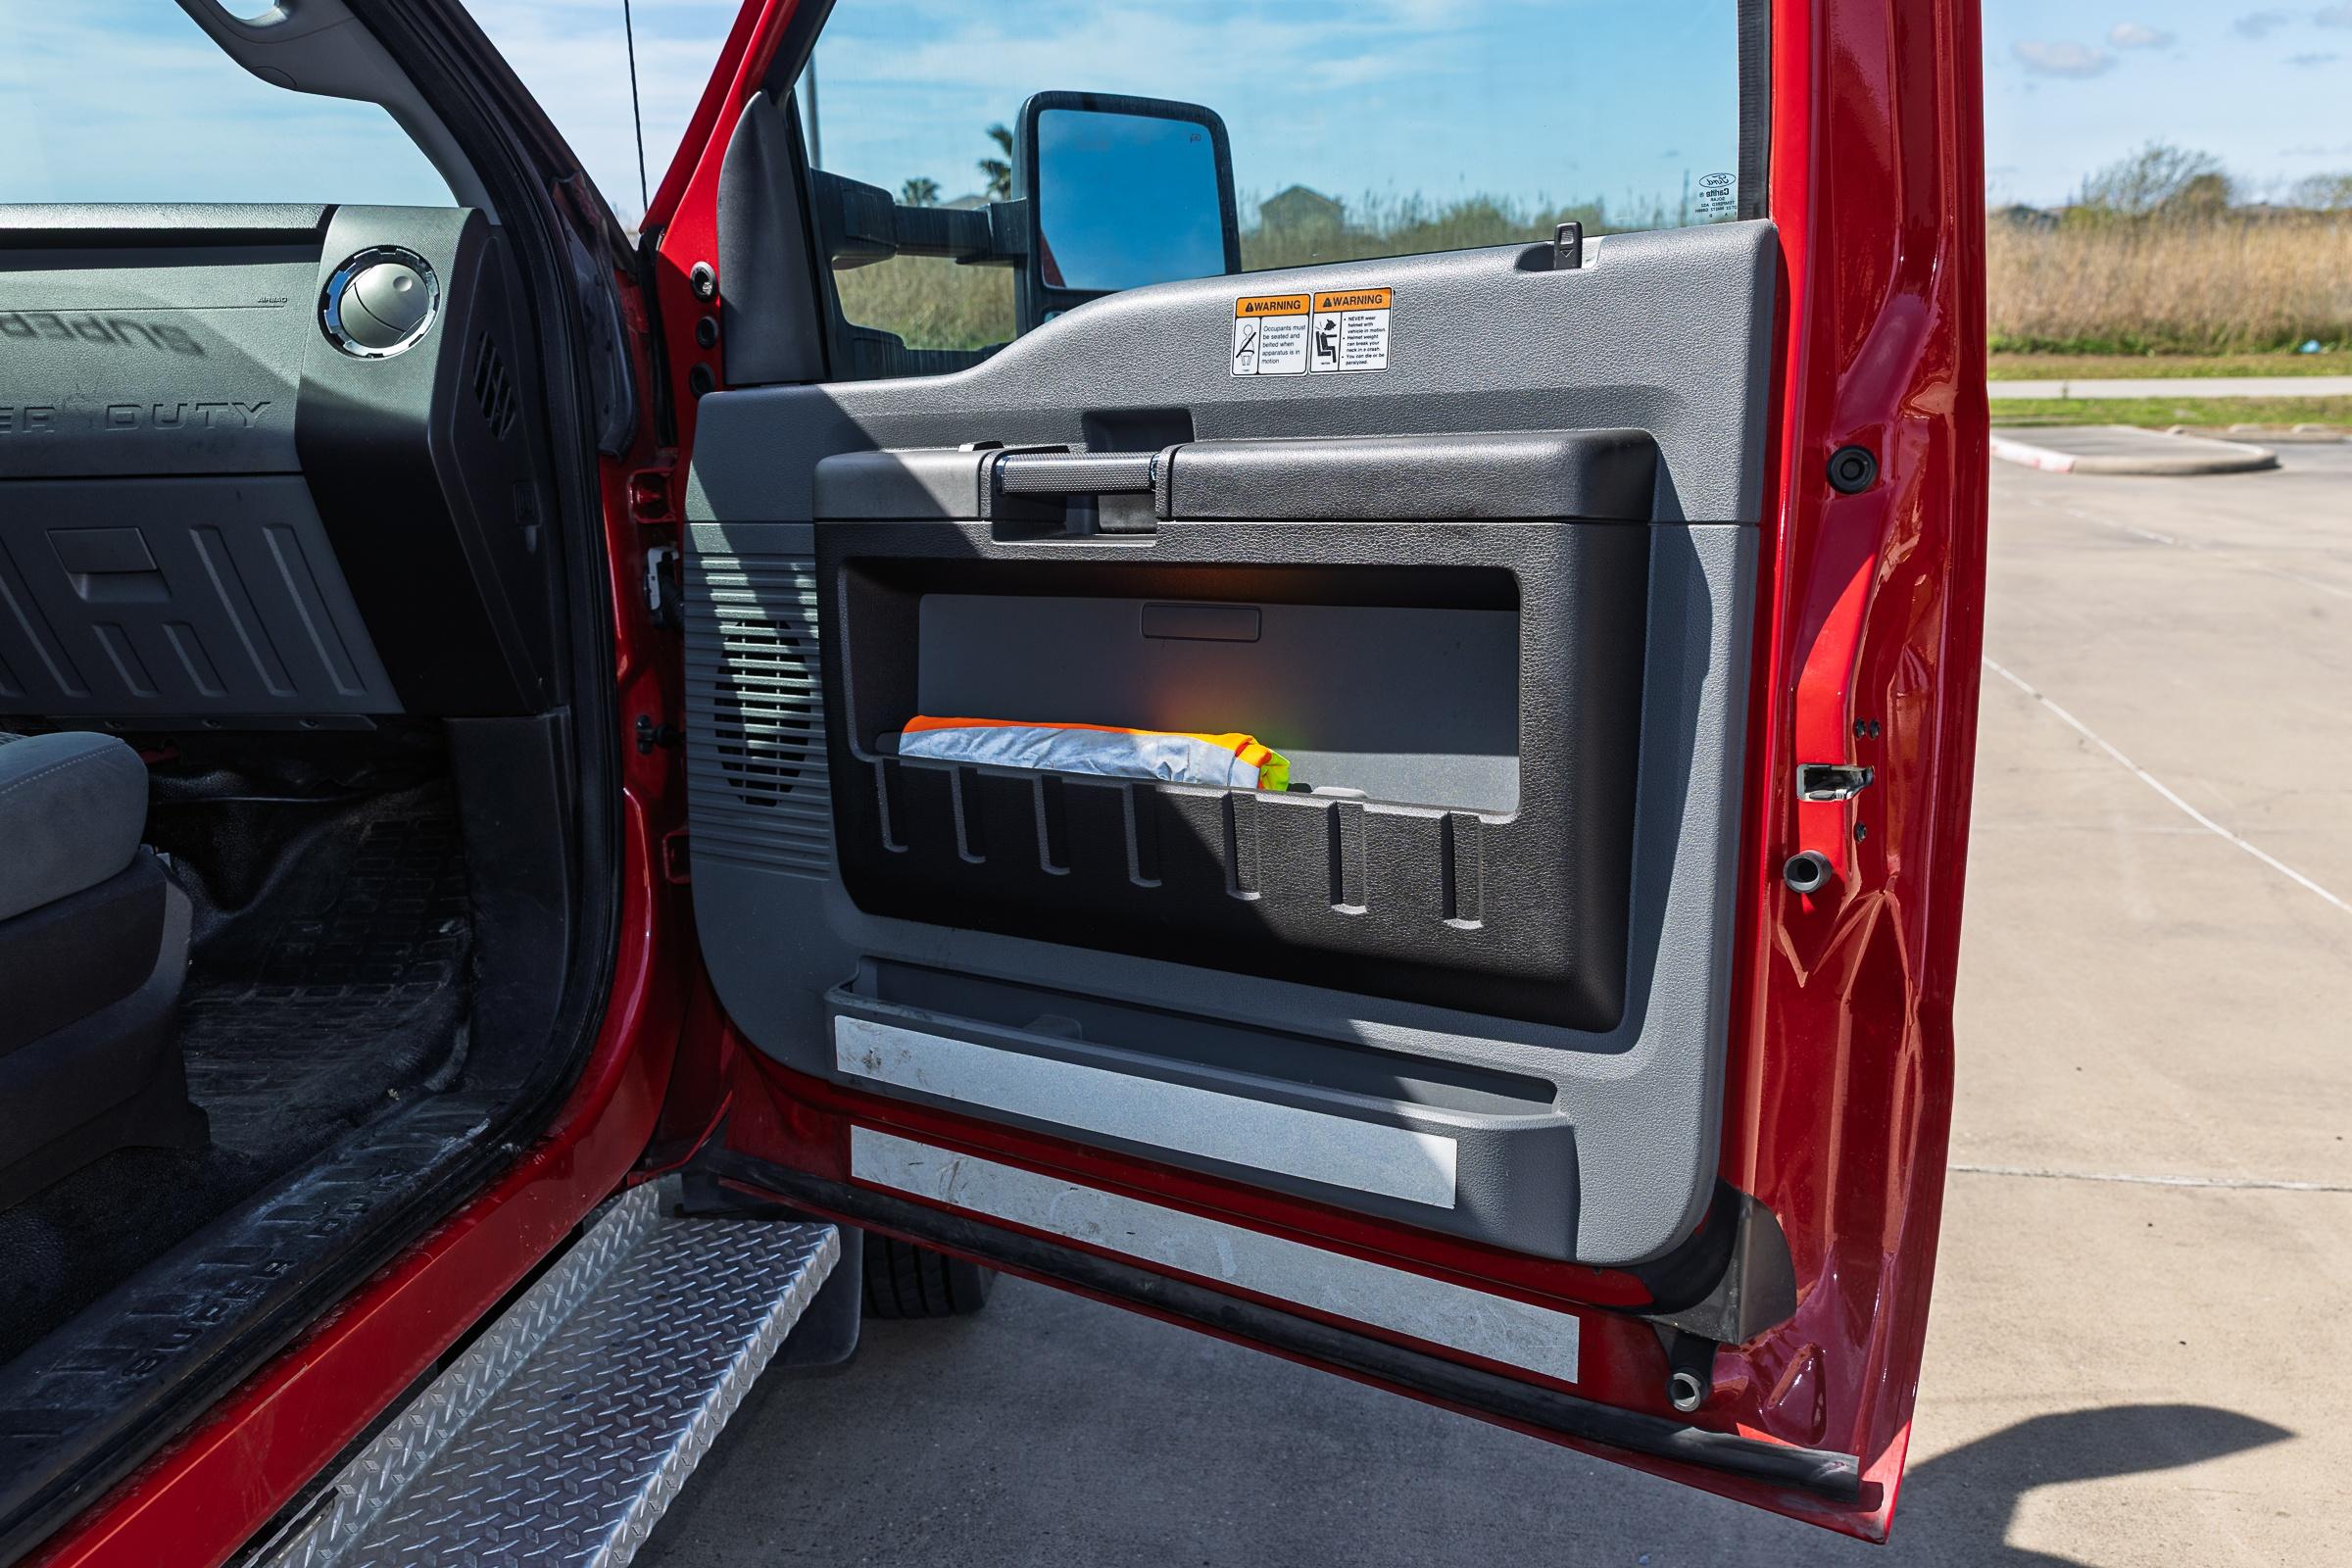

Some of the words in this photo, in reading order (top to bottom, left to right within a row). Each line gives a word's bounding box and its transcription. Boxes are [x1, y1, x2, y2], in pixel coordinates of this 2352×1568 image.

[1254, 300, 1301, 312] WARNING
[1333, 294, 1383, 306] WARNING
[105, 401, 271, 431] DUTY
